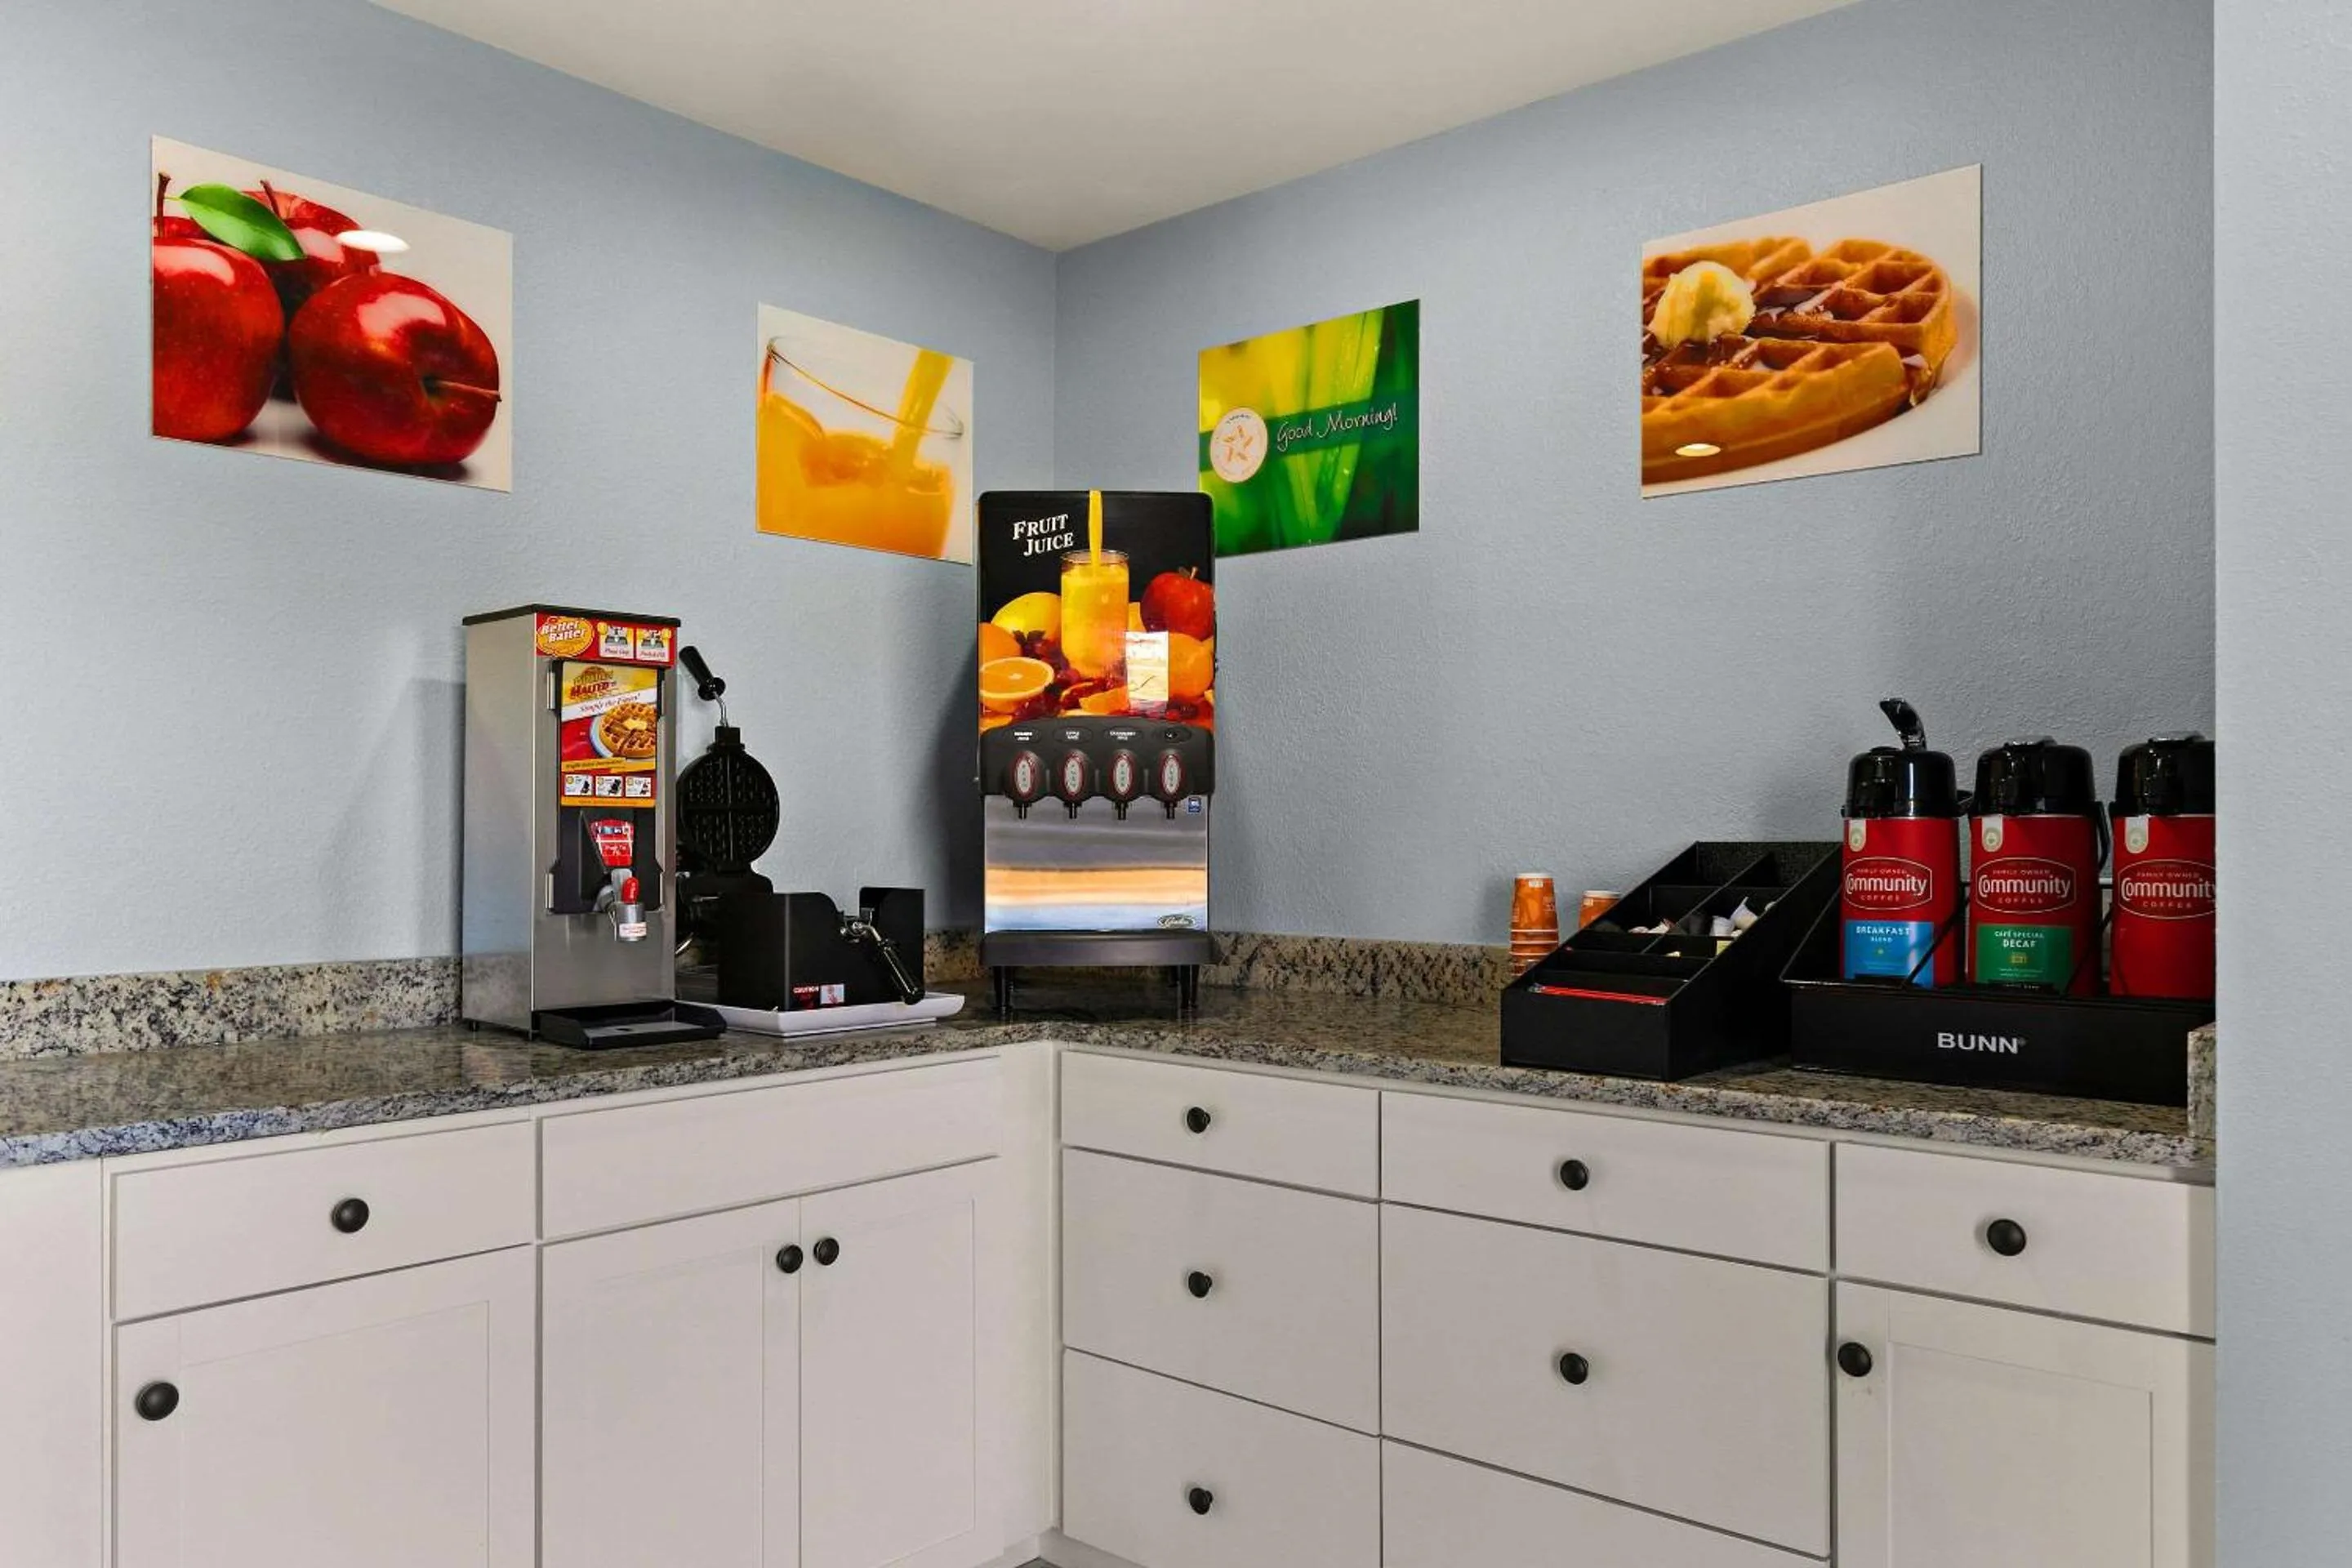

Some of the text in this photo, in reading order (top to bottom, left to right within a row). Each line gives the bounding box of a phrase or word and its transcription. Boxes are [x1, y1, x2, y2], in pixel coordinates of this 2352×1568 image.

[1277, 402, 1399, 452] Good Morning!
[1013, 514, 1068, 540] FRUIT
[1023, 532, 1074, 556] JUICE
[1846, 873, 1927, 897] Community
[1978, 875, 2071, 898] Community
[1855, 926, 1910, 936] BREAKFAST
[2002, 939, 2037, 948] DECAF
